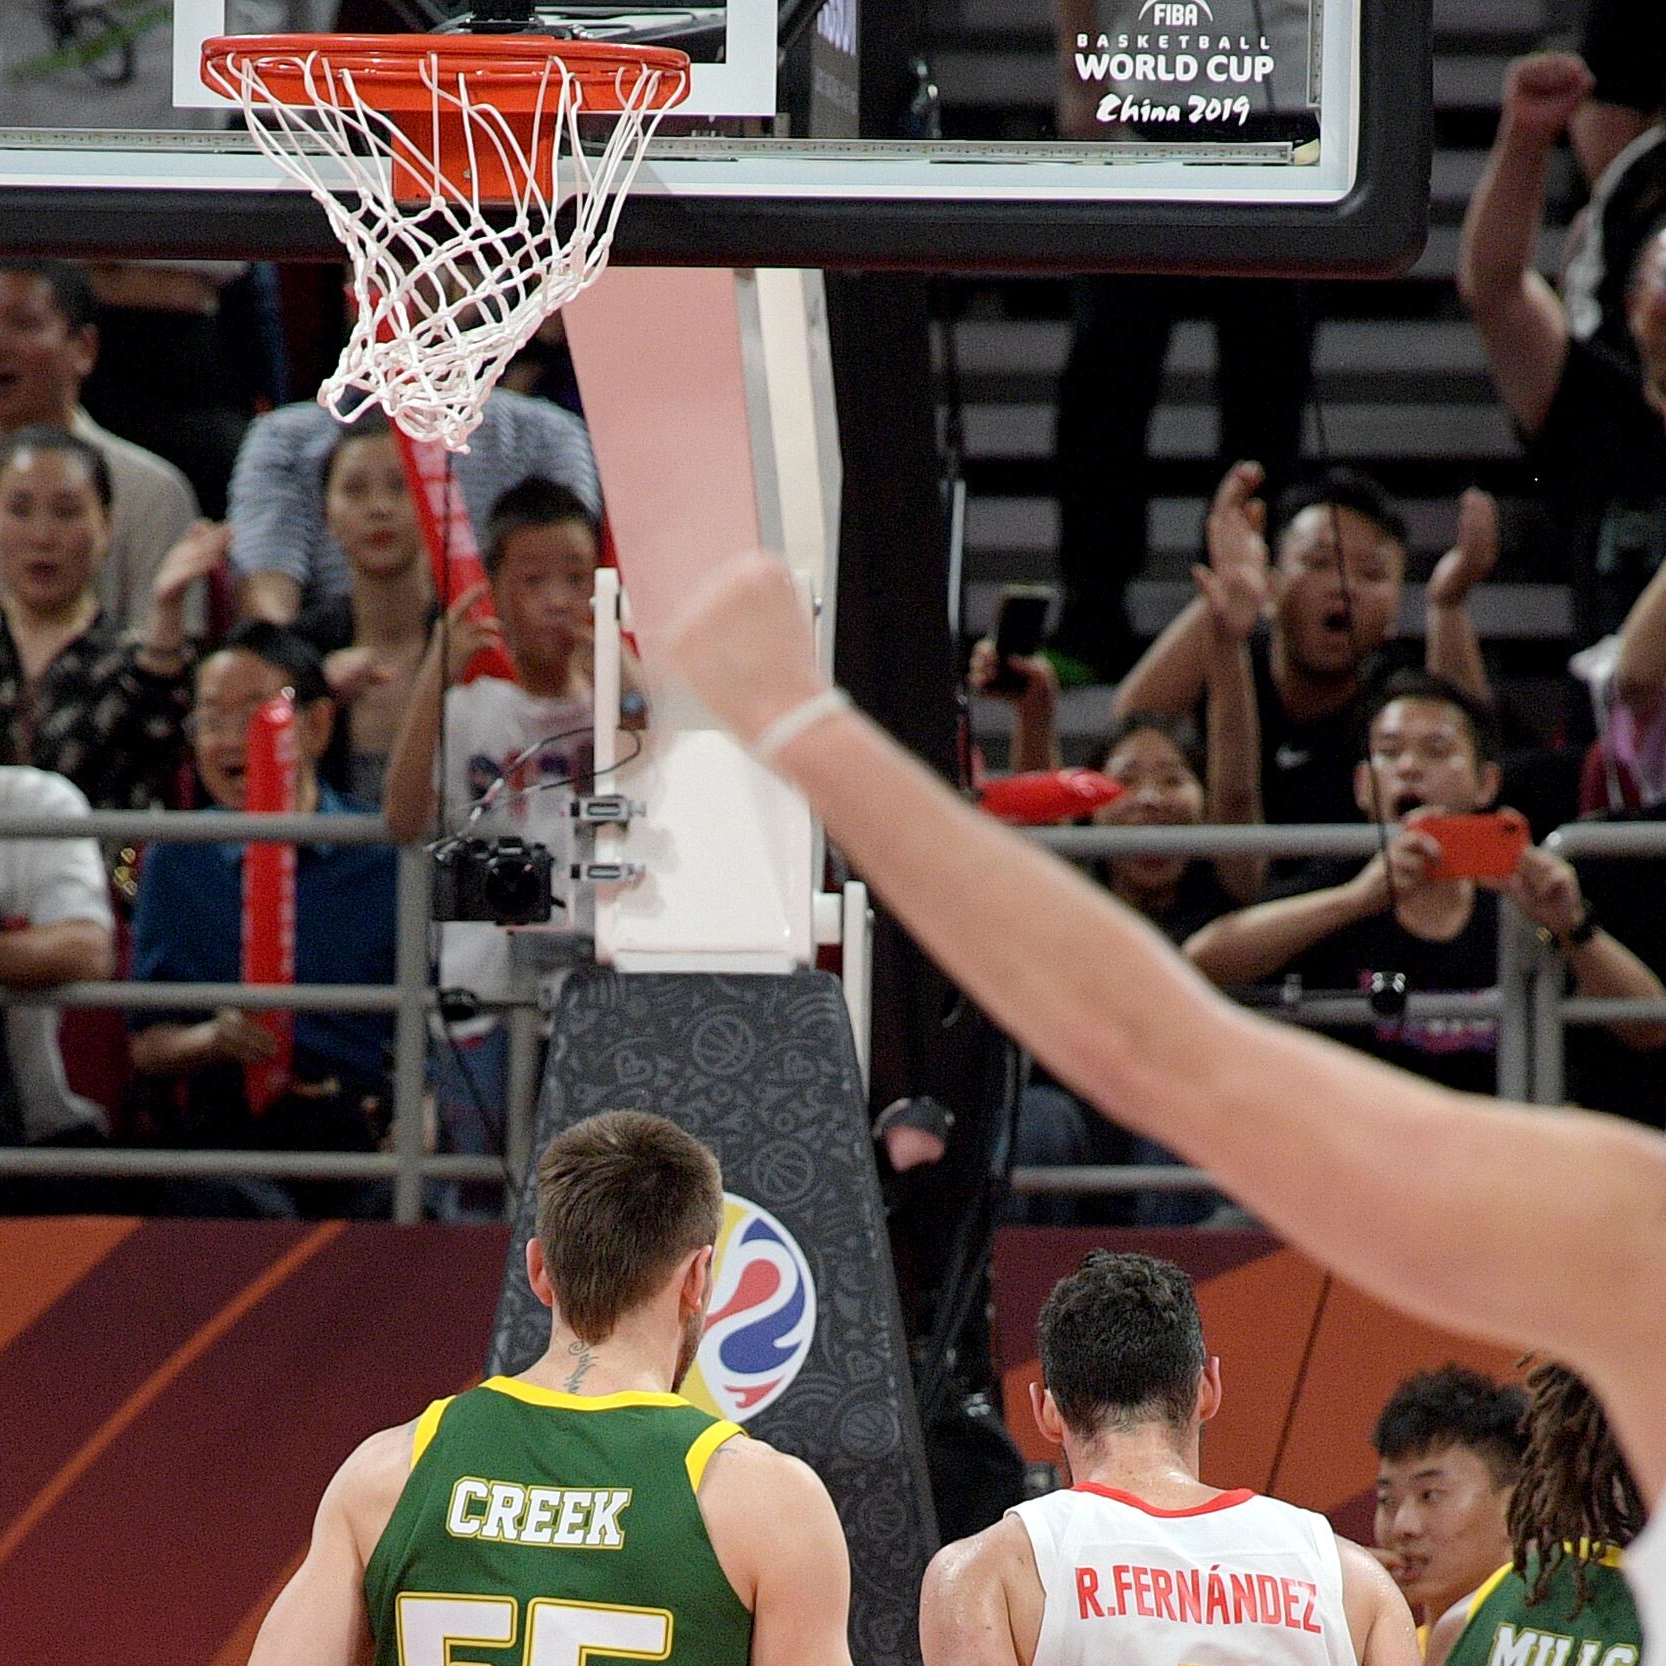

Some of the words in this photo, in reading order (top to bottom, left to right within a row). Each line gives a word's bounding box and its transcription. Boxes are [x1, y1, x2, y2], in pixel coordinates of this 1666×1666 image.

[1154, 3, 1198, 26] FIBA
[1076, 33, 1271, 50] BASKETBALL
[1074, 53, 1199, 82] WORLD
[1206, 54, 1275, 83] CUP
[1096, 92, 1181, 123] China
[1188, 94, 1250, 126] 2019
[446, 1475, 633, 1551] CREEK
[1075, 1564, 1322, 1634] R.FERNÁNDEZ
